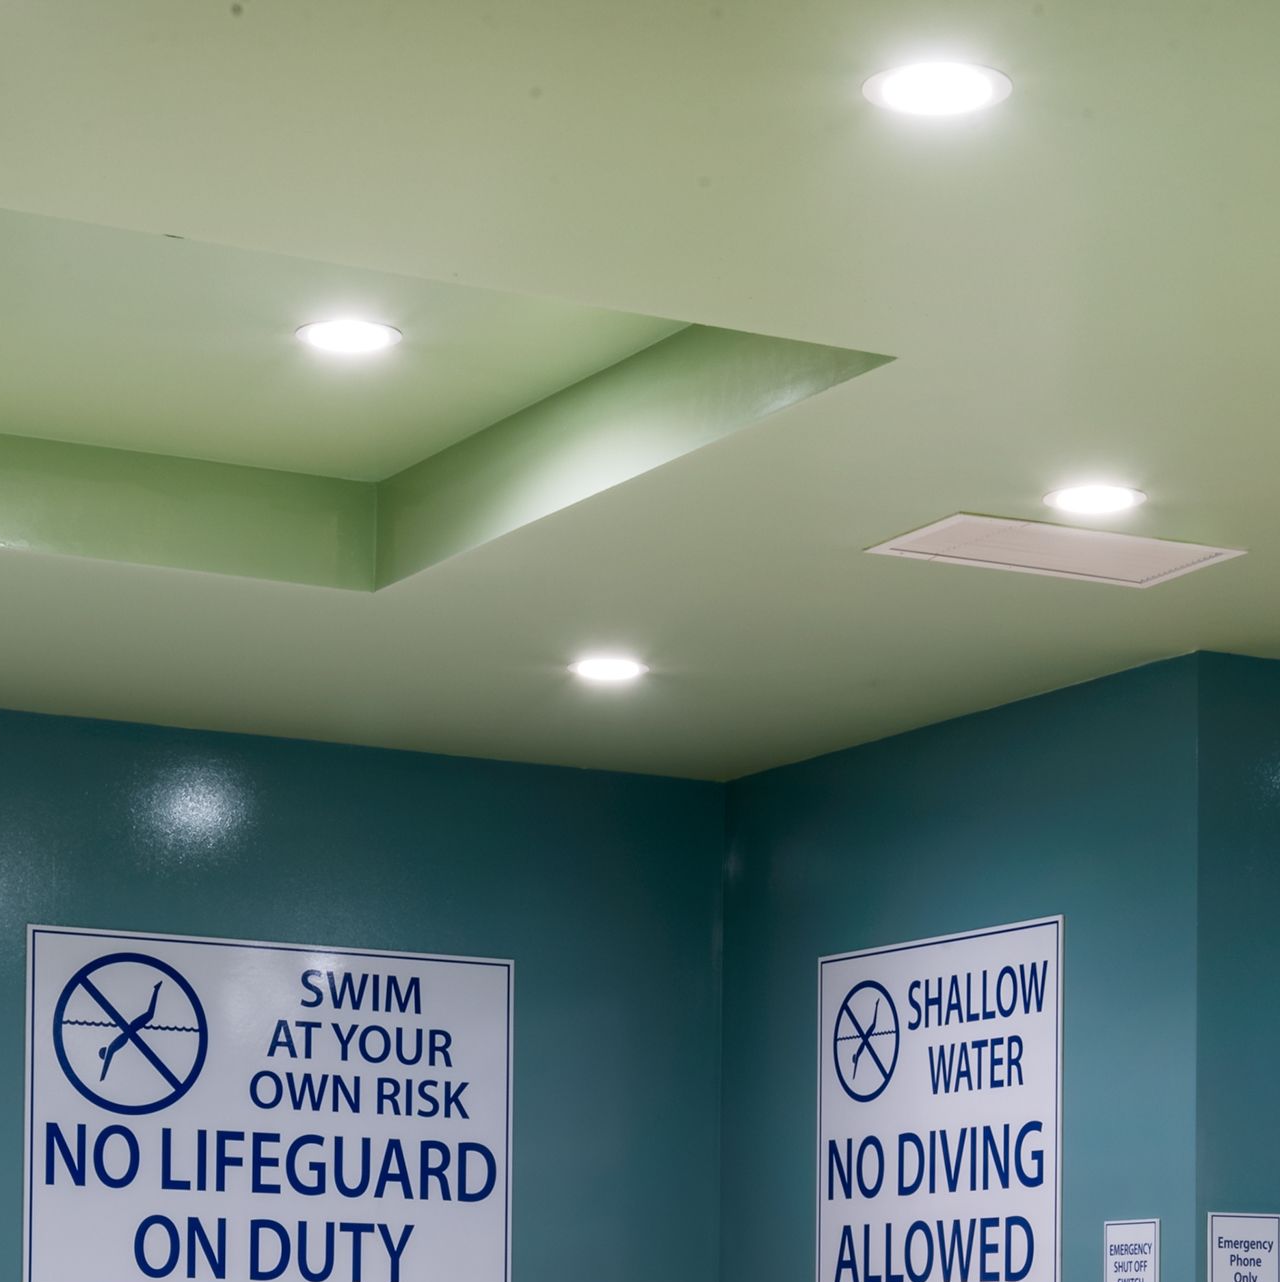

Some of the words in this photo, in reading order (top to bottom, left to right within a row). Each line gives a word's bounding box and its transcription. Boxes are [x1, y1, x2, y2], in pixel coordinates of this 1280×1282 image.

[301, 970, 421, 1014] SWIM
[908, 960, 1048, 1030] SHALLOW
[267, 1020, 322, 1059] AT
[331, 1023, 452, 1067] YOUR
[928, 1035, 1023, 1094] WATER
[250, 1071, 360, 1113] OWN
[377, 1078, 469, 1119] RISK
[46, 1122, 139, 1188] NO
[162, 1128, 496, 1202] LIFEGUARD
[828, 1135, 884, 1200] NO
[898, 1121, 1043, 1196] DIVING
[134, 1215, 226, 1279] ON
[1110, 1243, 1152, 1256] EMERGENCY
[1114, 1261, 1132, 1273] SHUT
[1135, 1260, 1147, 1272] OFF
[1218, 1237, 1273, 1253] Emergency
[1230, 1255, 1261, 1267] Phone
